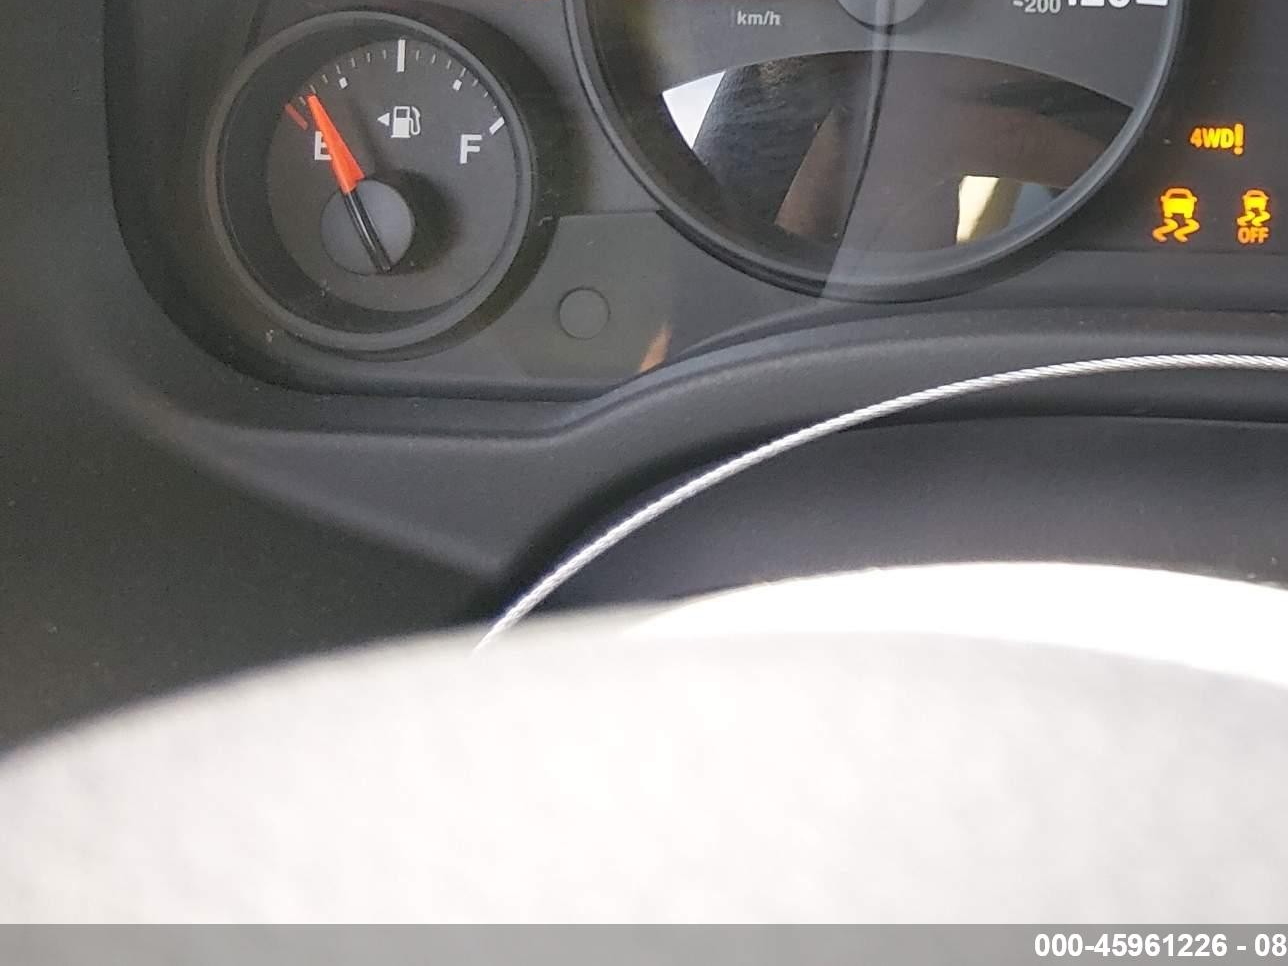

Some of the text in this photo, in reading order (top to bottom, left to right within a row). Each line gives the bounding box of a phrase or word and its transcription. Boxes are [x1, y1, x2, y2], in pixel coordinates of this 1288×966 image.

[737, 9, 780, 28] km/h
[460, 135, 482, 163] F
[1190, 123, 1244, 155] 4WD!
[1238, 227, 1269, 244] OFF
